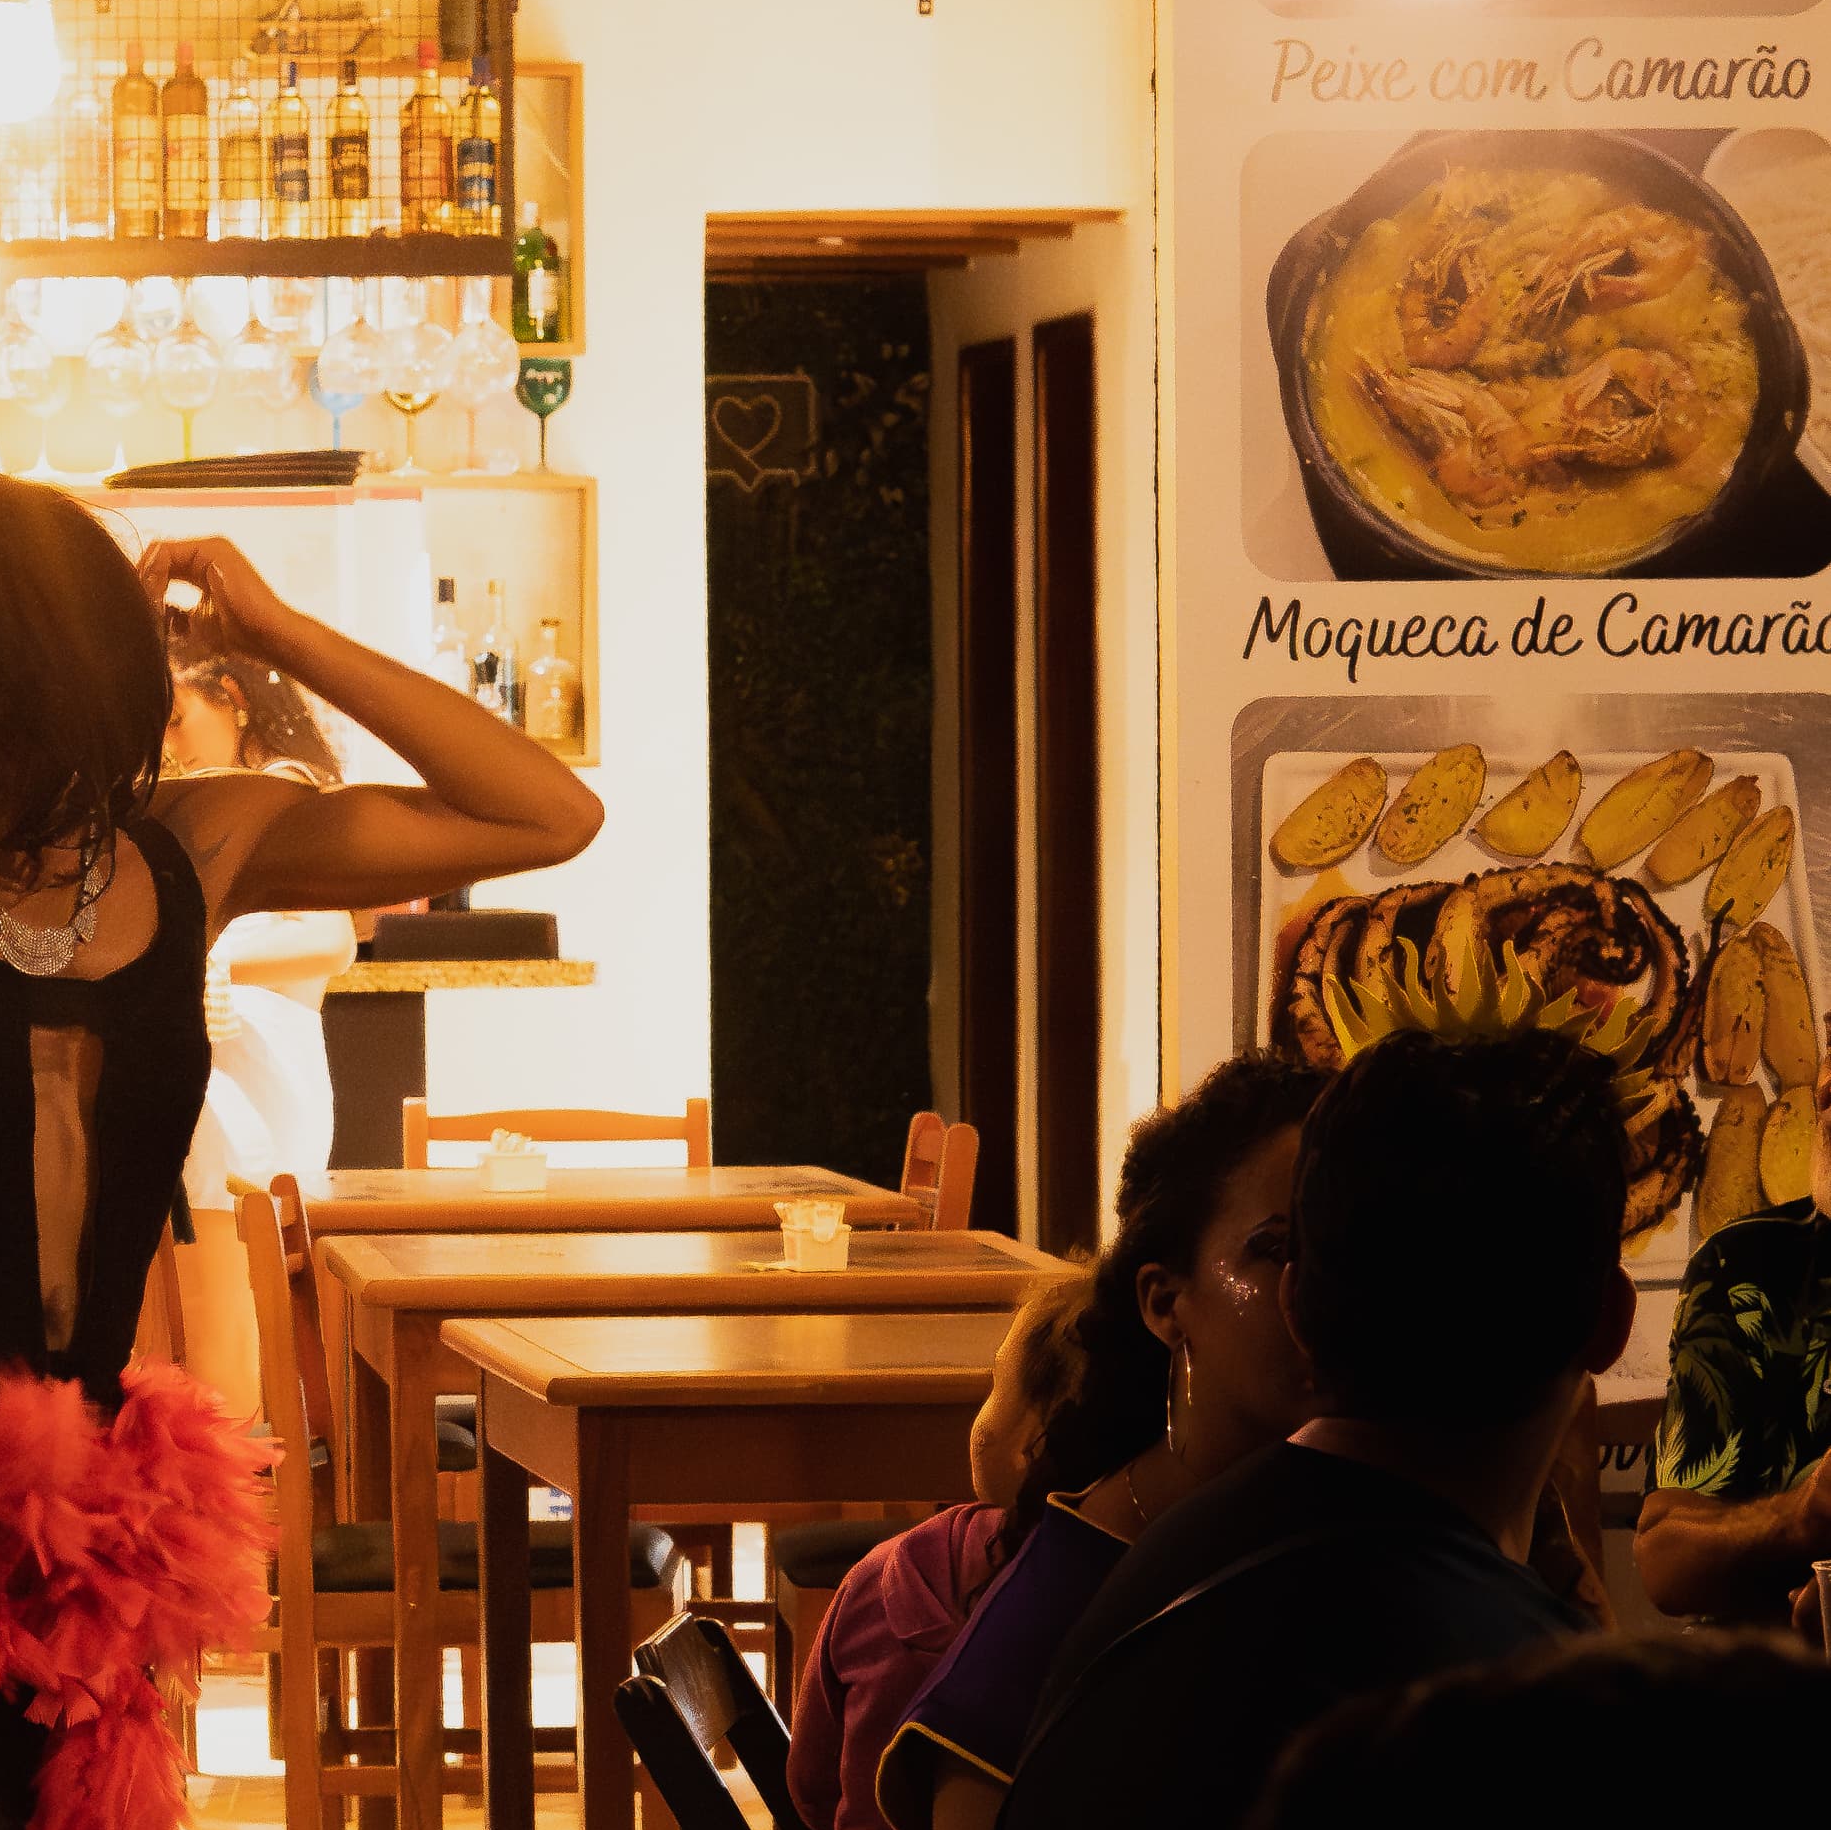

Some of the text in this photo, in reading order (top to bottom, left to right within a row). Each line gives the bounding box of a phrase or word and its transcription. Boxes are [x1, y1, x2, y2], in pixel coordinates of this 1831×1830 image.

[1271, 36, 1811, 103] Peixe com Camarão
[1242, 596, 1499, 683] Moqueca
[1511, 597, 1583, 659] de
